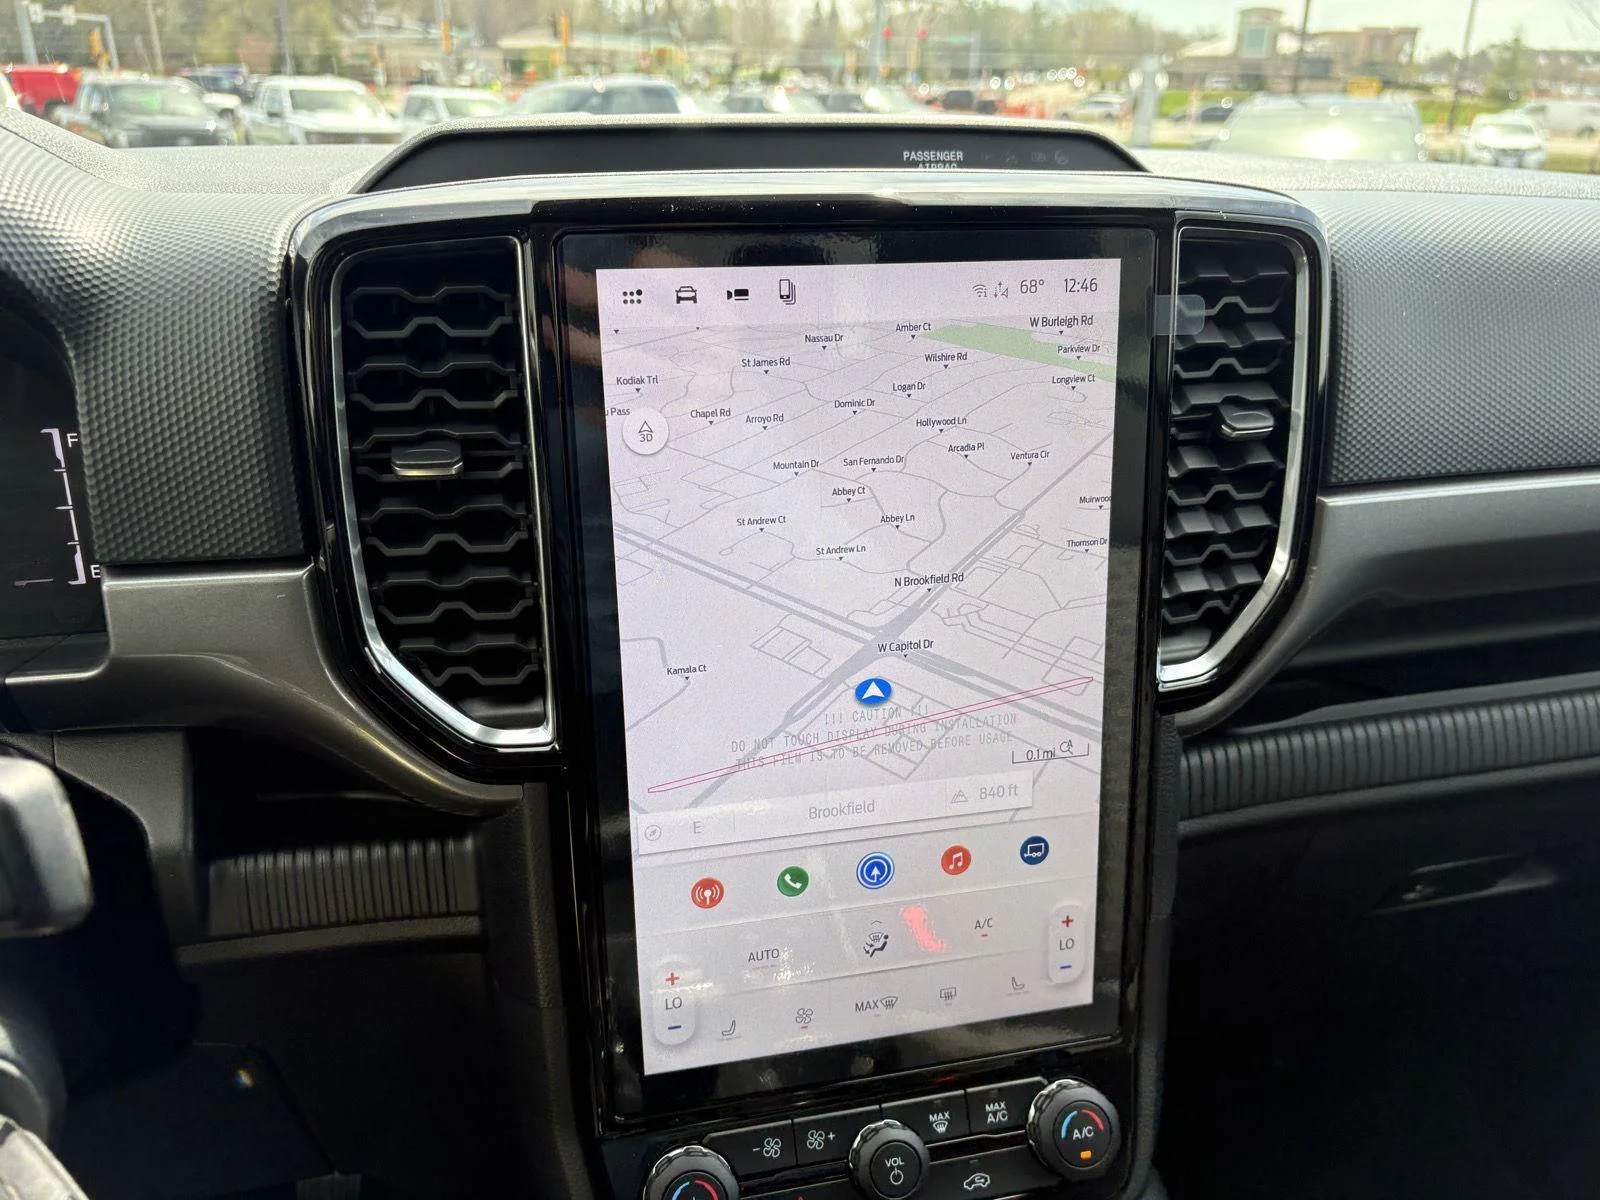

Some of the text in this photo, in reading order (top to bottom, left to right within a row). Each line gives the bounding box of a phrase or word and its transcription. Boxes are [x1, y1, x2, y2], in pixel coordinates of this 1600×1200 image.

[903, 151, 964, 161] PASSENGER
[1064, 278, 1098, 293] 12:46
[1030, 315, 1094, 329] W Burleigh Rd
[895, 323, 931, 333] Amber Ct
[804, 333, 844, 343] Nassau Dr
[1057, 344, 1100, 354] Parkview Dr
[741, 357, 791, 367] St James Rd
[925, 352, 968, 362] Wilshire Rd
[616, 375, 659, 385] Kodiak Trl
[1052, 374, 1095, 385] Longview Ct
[892, 381, 926, 393] Logan Dr
[834, 398, 876, 409] Dominic Dr
[610, 407, 631, 416] Pass
[690, 408, 731, 419] Chapel Rd
[745, 413, 784, 424] Arroyo Rd
[916, 416, 967, 428] Hollywood Ln
[67, 433, 78, 447] F
[639, 433, 653, 443] 3D
[948, 442, 985, 453] Arcadia Pl
[1010, 450, 1050, 460] Ventura Cir
[773, 459, 820, 470] Mountain Dr
[843, 455, 905, 467] San Fernando Dr
[832, 486, 866, 497] Abbey Ct
[736, 515, 786, 526] St Andrew Ct
[880, 513, 915, 524] Abbey Ln
[1099, 537, 1108, 546] Dr
[816, 544, 866, 556] St Andrew Ln
[894, 572, 964, 587] N Brookfield Rd
[878, 639, 934, 653] W Capitol Dr
[667, 664, 707, 676] Kamala Ct
[853, 708, 902, 724] CAUTION
[731, 712, 1017, 753] DO NOT TOUCH DISPLAY DURING INSTALLATION
[735, 730, 1014, 772] THIS FILM IS TO BE REMOVED BEFORE USAGE
[979, 783, 1019, 800] 840 ft
[809, 799, 876, 820] Brookfield
[693, 820, 702, 834] E
[974, 917, 993, 930] A/C
[1059, 937, 1075, 951] LO
[748, 948, 780, 963] AUTO
[665, 996, 683, 1010] LO
[855, 1000, 880, 1012] MAX
[985, 1101, 1007, 1112] MAX
[929, 1112, 951, 1123] MAX
[987, 1111, 1009, 1125] A/C
[1072, 1127, 1094, 1140] A/C
[885, 1157, 905, 1168] VOL
